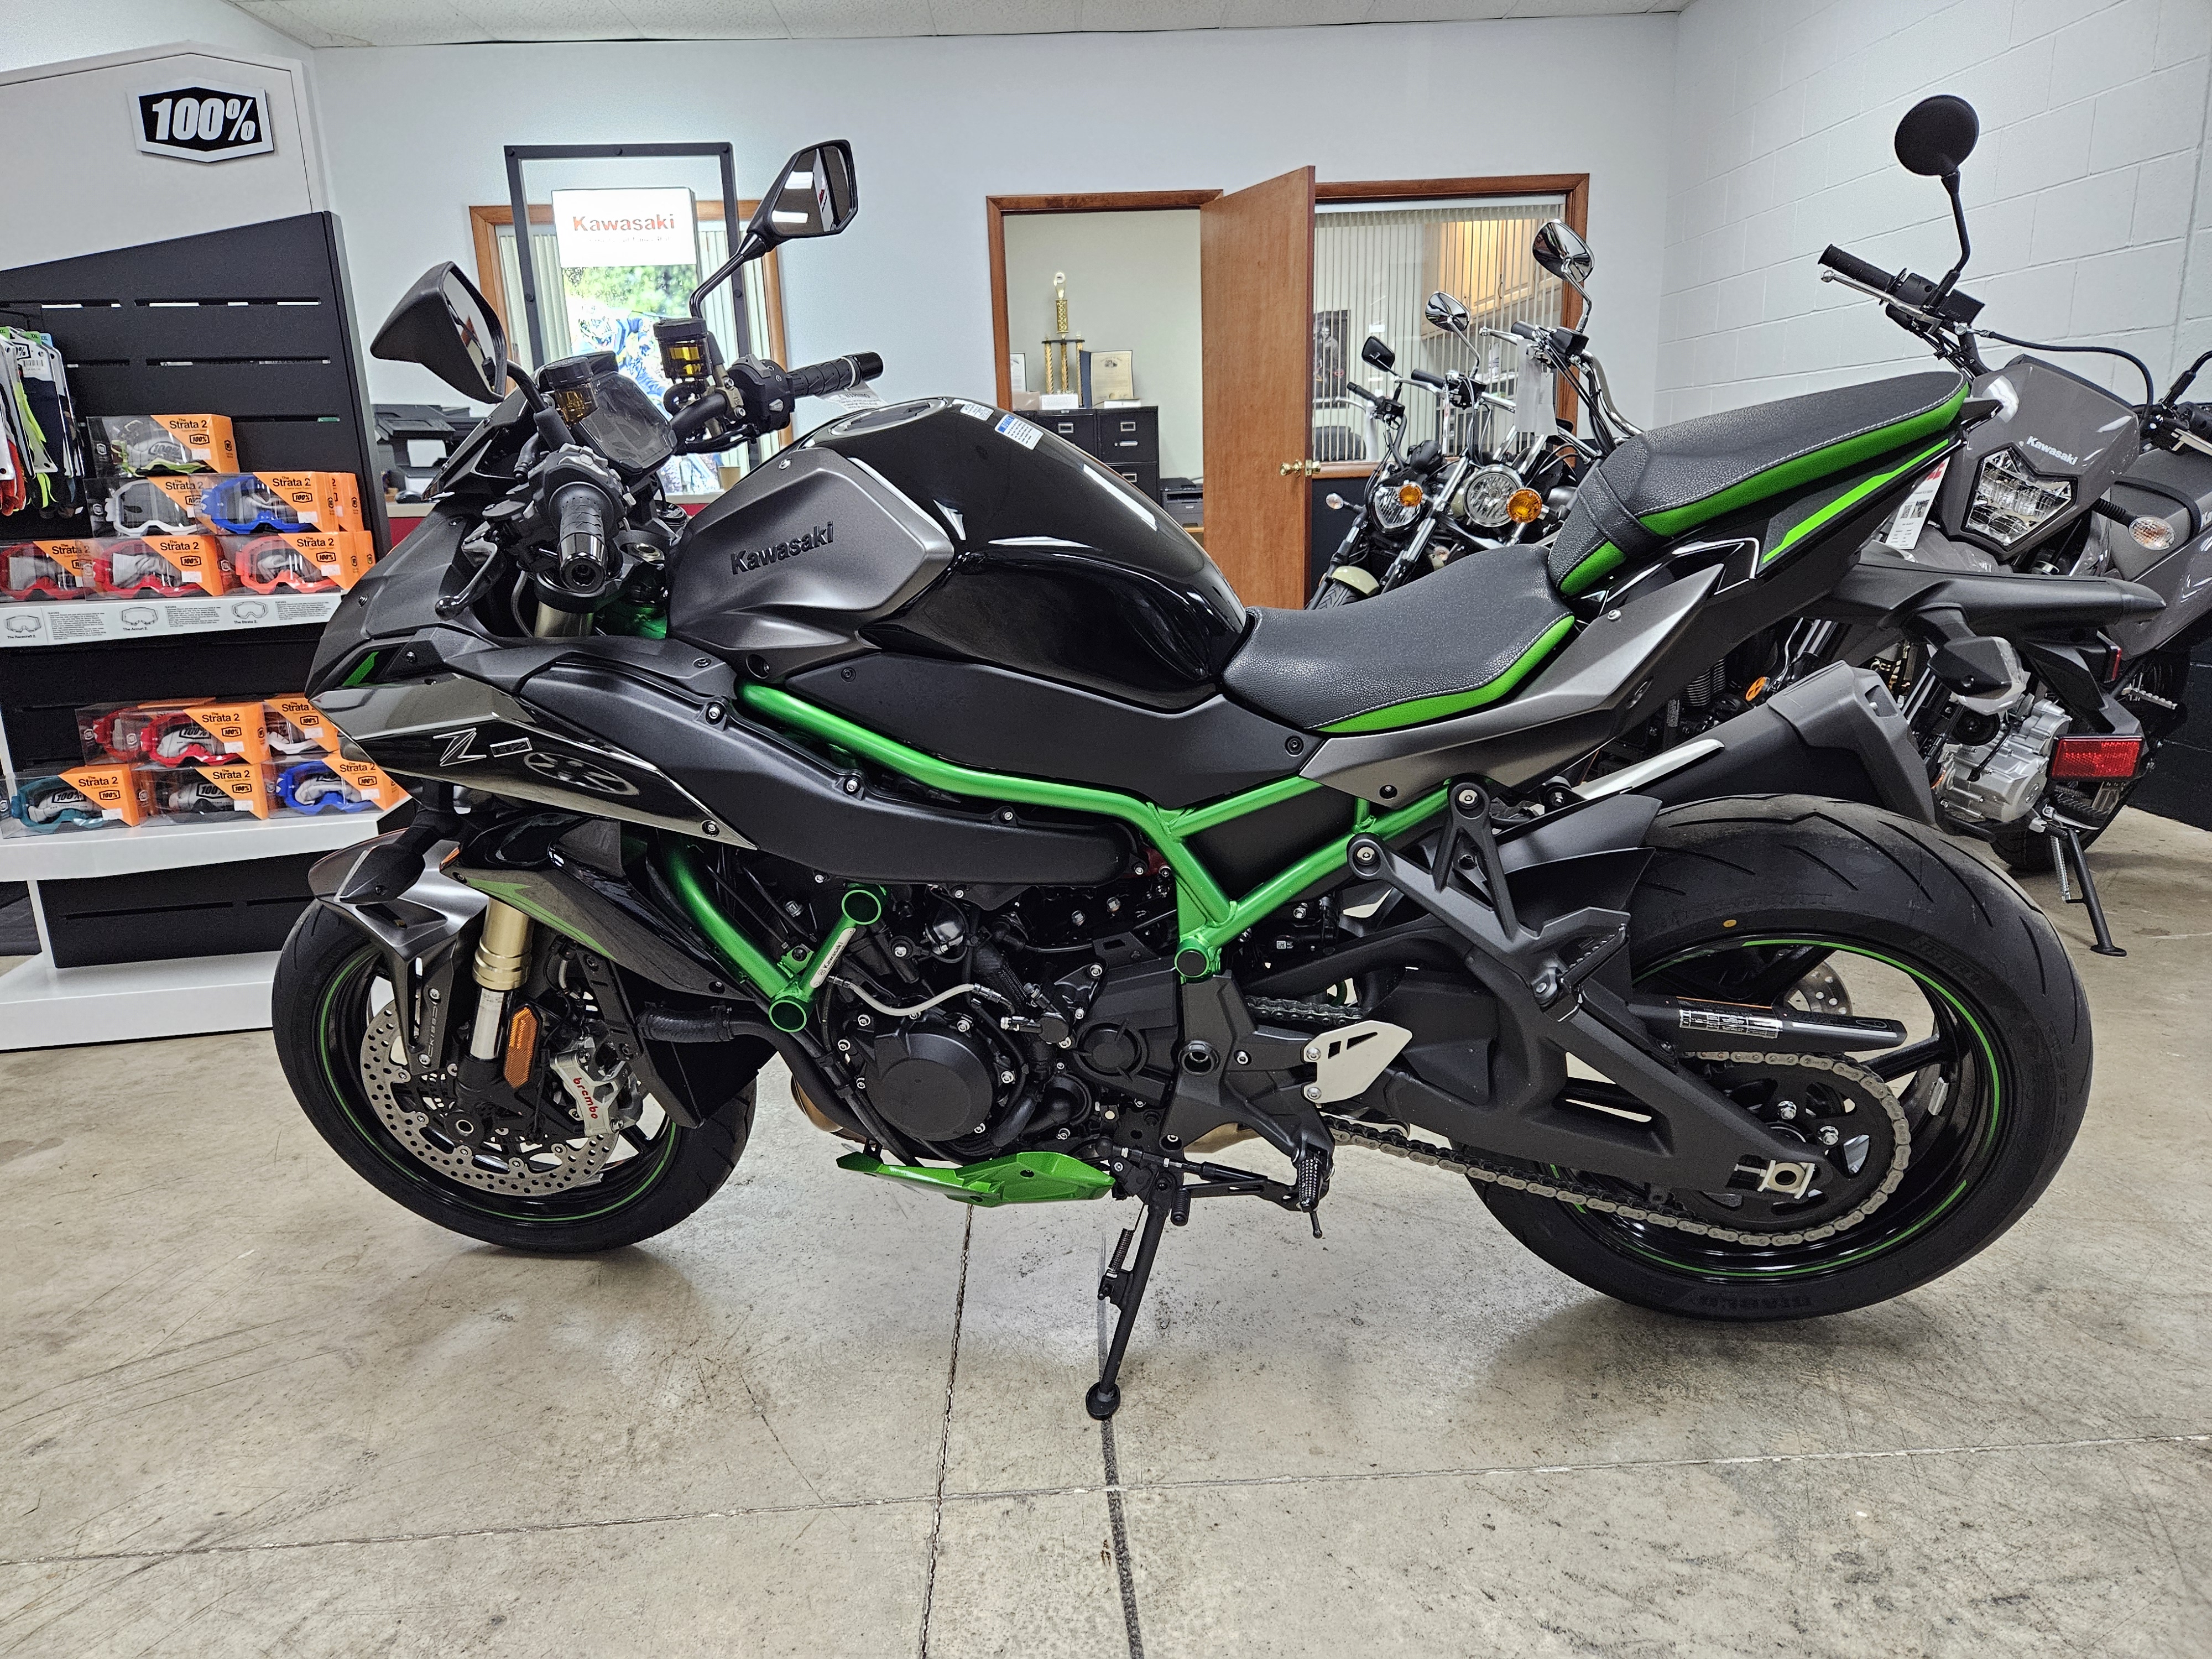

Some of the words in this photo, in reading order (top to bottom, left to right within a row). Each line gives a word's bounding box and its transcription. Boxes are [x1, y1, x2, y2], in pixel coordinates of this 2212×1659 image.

[152, 97, 256, 141] 100%
[573, 213, 675, 231] Kawasaki
[169, 420, 199, 429] Strata
[2026, 436, 2078, 465] Kawasaki
[165, 482, 196, 490] Strata
[272, 478, 302, 487] Strata
[160, 542, 190, 551] Strata
[328, 538, 335, 546] 2
[52, 546, 82, 555] Strata
[731, 521, 834, 575] Kawasaki
[202, 714, 231, 723] Strata
[340, 764, 368, 773] Strata
[213, 771, 242, 780] Strata
[244, 770, 251, 778] 2
[79, 778, 109, 787] Strata
[823, 942, 843, 969] Kawasaki
[573, 1077, 598, 1119] brembo
